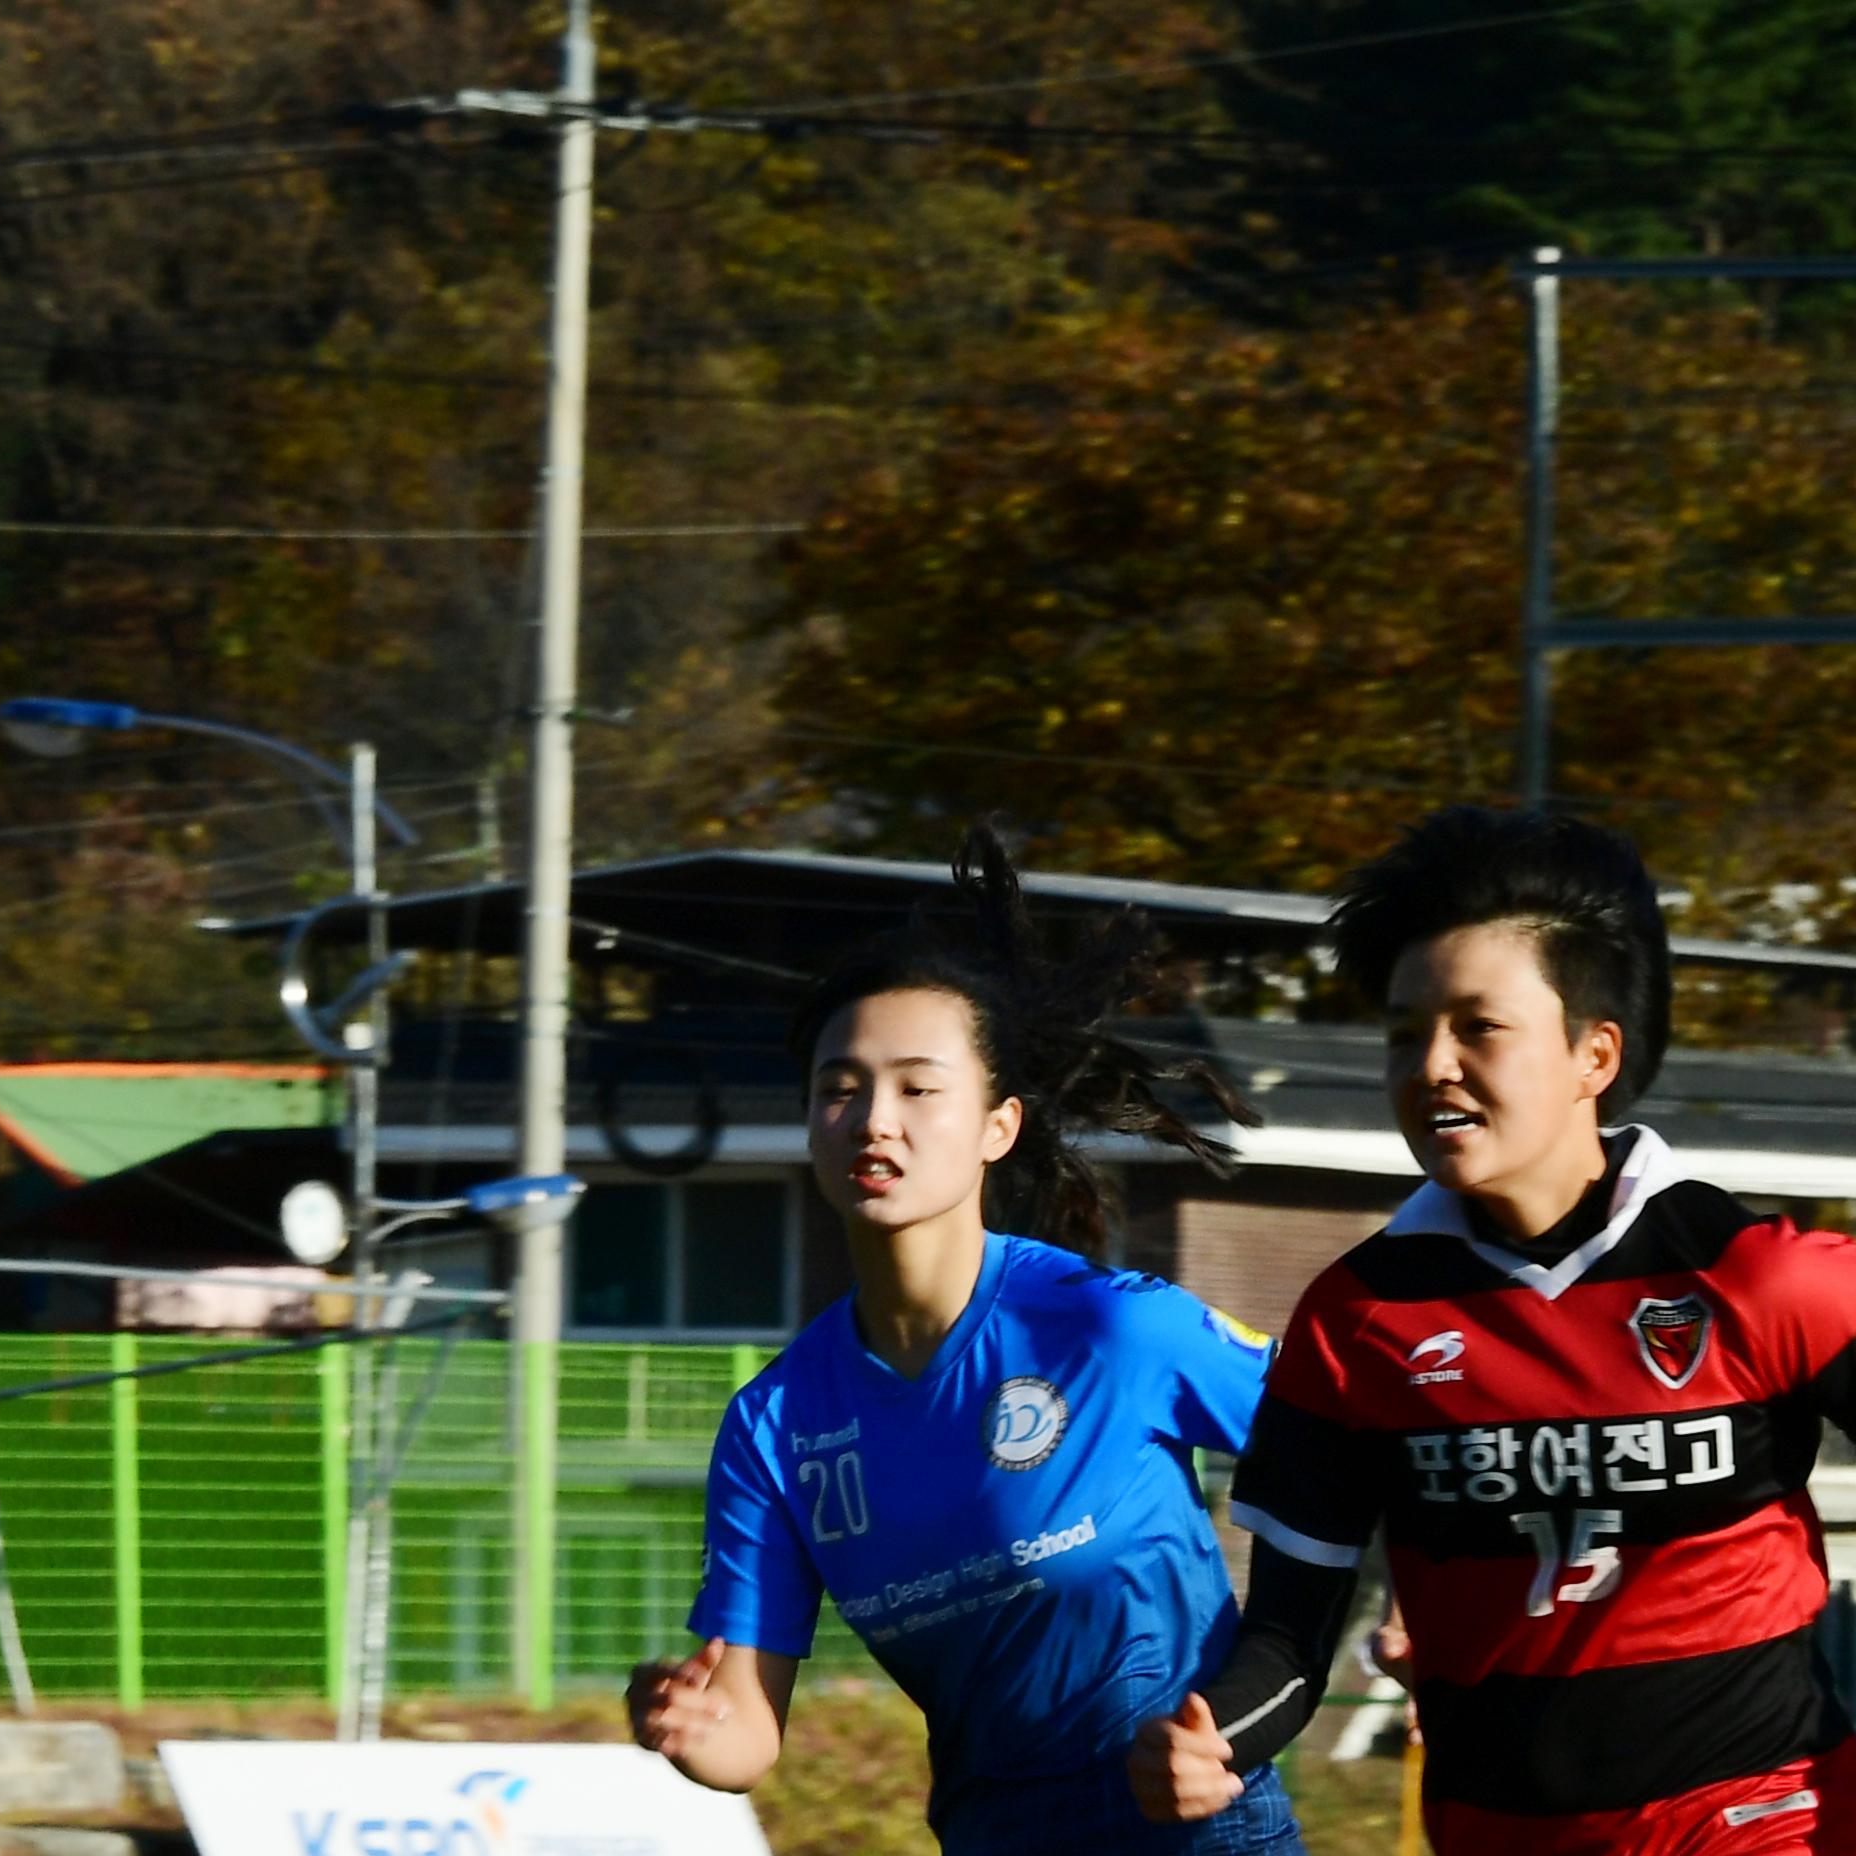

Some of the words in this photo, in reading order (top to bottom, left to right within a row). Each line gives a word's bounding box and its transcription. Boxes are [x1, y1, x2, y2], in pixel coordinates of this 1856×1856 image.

[798, 1450, 870, 1543] 20
[1405, 1414, 1736, 1503] 포항여전고
[885, 1567, 956, 1609] Design
[1010, 1515, 1097, 1567] School
[1509, 1508, 1624, 1617] 15
